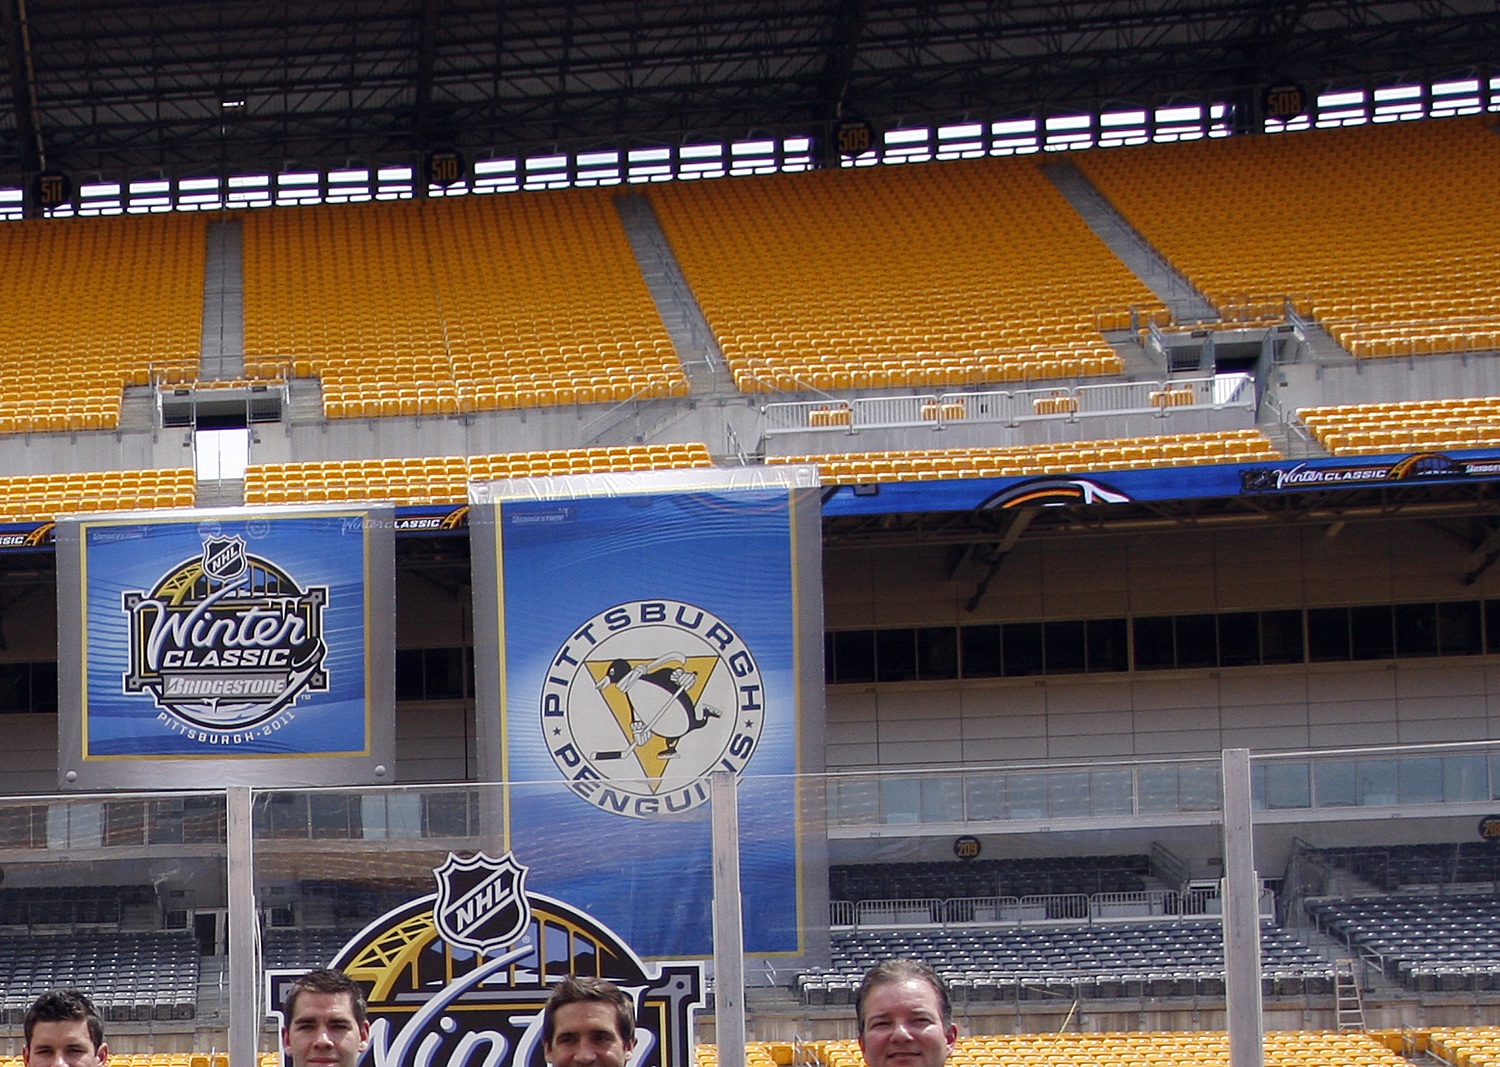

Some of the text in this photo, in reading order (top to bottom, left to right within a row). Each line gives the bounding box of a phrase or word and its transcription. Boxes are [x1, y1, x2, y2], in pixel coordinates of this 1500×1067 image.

[1267, 91, 1301, 115] 508
[838, 128, 870, 151] 509
[431, 158, 457, 180] 510
[41, 181, 63, 203] 511
[1323, 469, 1387, 481] CLASSIC
[211, 546, 238, 572] NHL
[133, 576, 306, 671] Winter
[162, 649, 291, 667] CLASSIC
[544, 603, 761, 717] PITTSBURGH
[166, 678, 285, 695] BRIDGESTONE
[156, 711, 296, 744] PITTSBURGH 2011
[957, 842, 978, 855] 209
[456, 878, 510, 933] NHL
